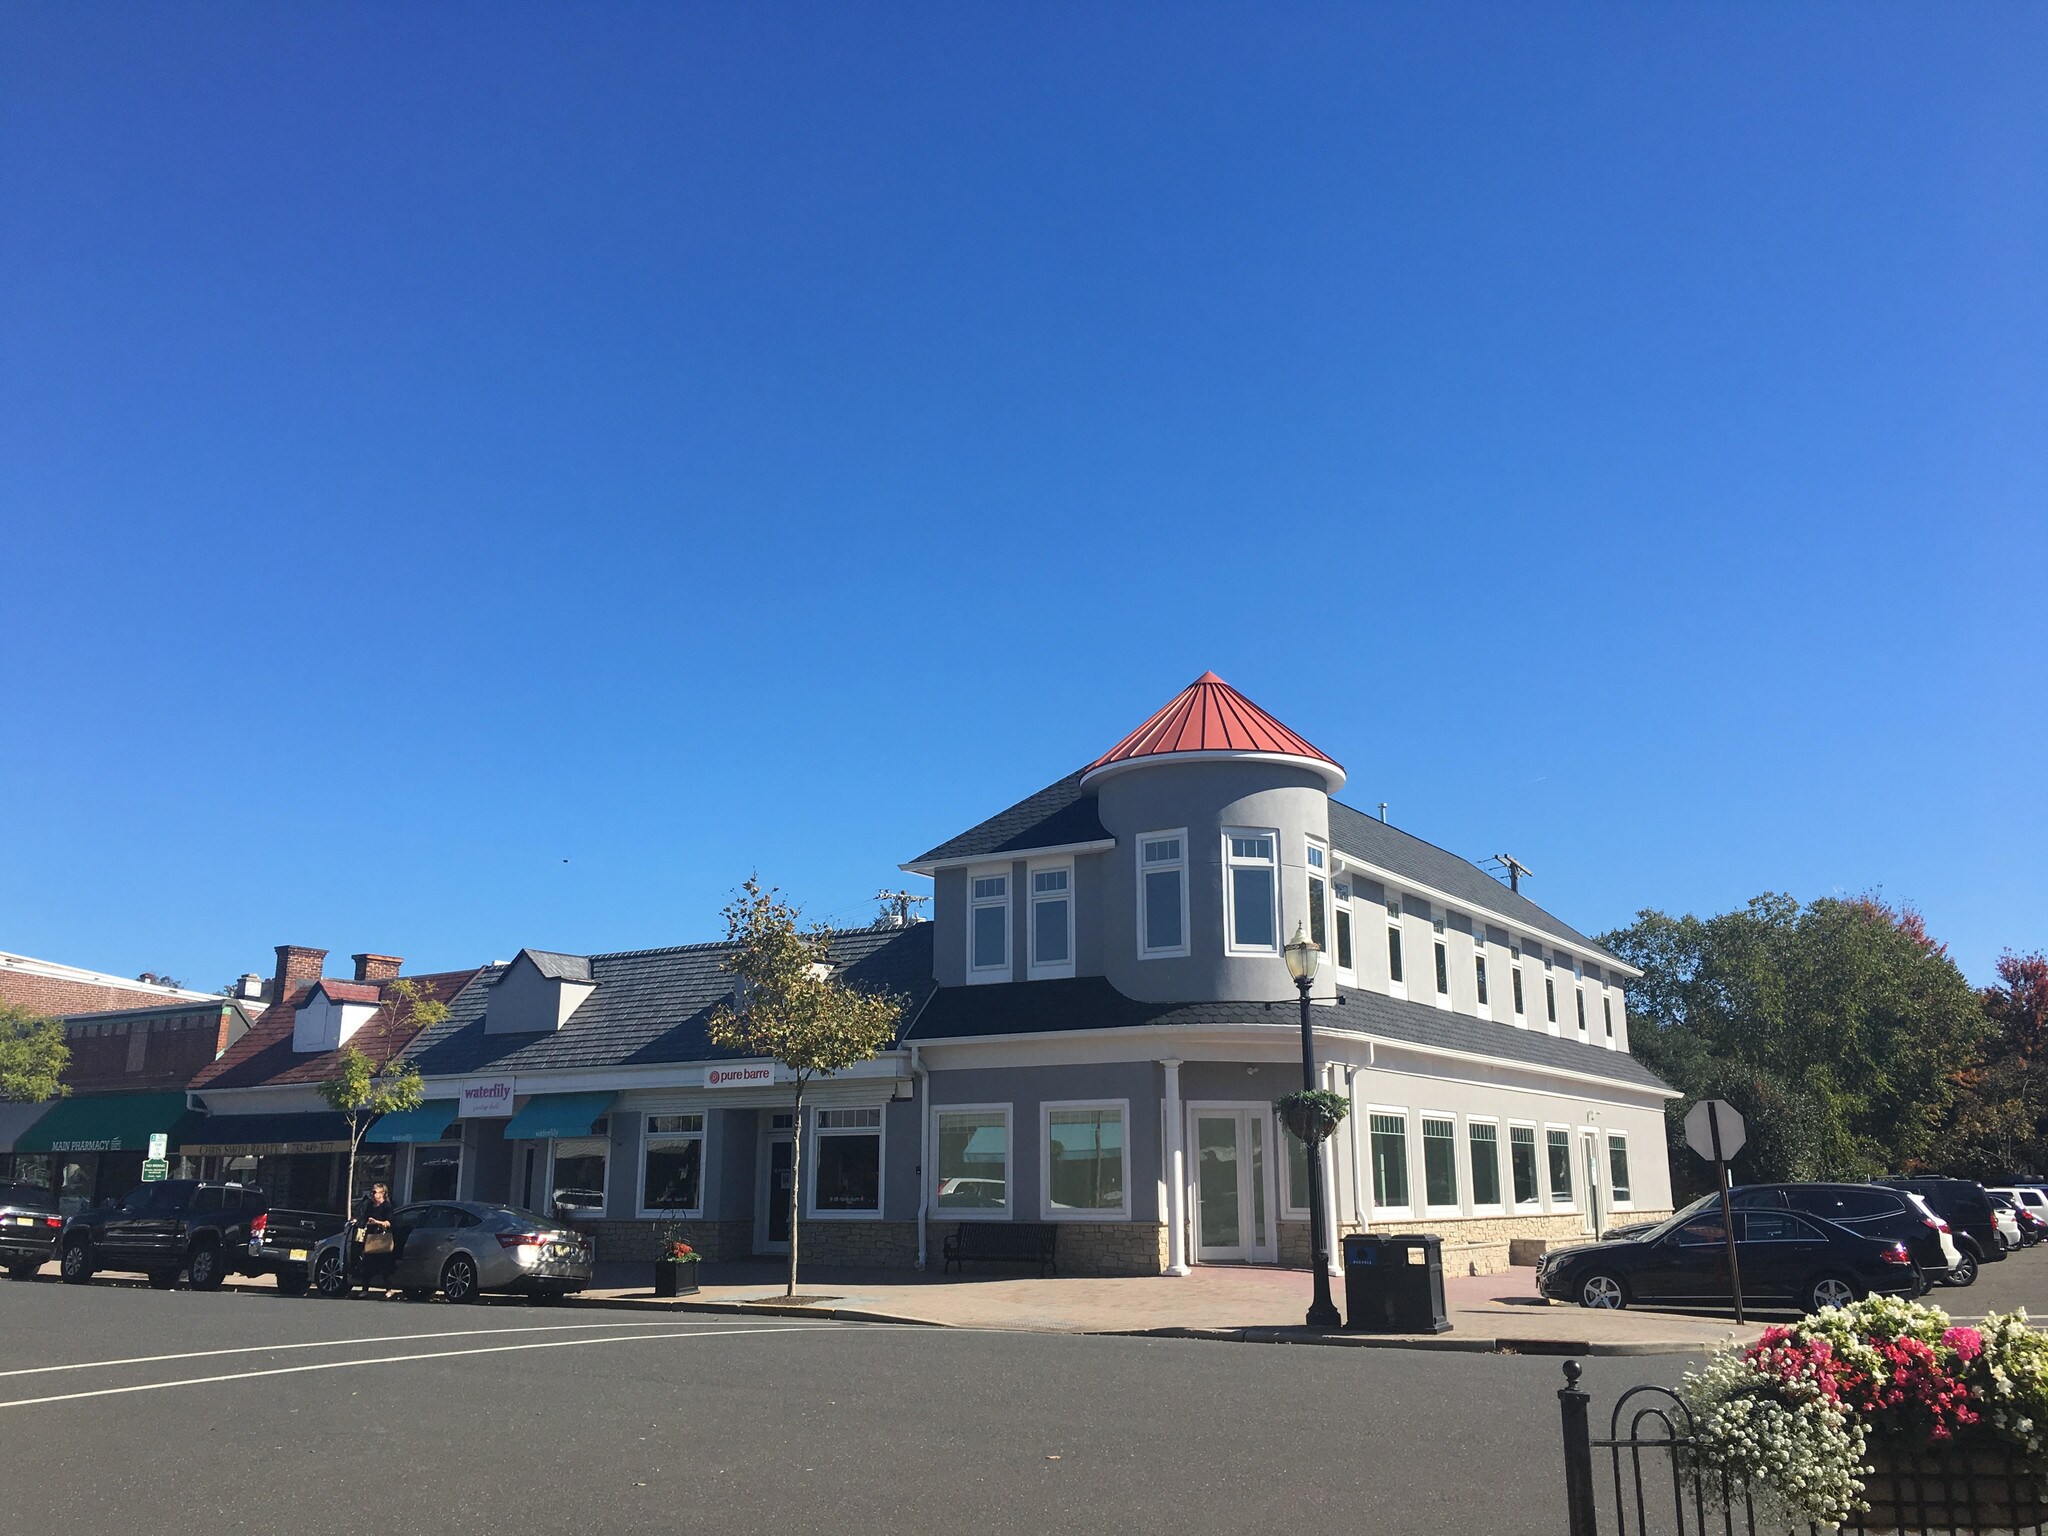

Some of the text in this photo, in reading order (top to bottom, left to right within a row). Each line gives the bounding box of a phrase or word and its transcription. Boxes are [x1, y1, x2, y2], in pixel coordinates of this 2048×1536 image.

[721, 1068, 769, 1083] pure barre
[52, 1141, 70, 1151] MAIN
[71, 1140, 110, 1151] PHARMACY
[224, 1145, 247, 1155] SMITH
